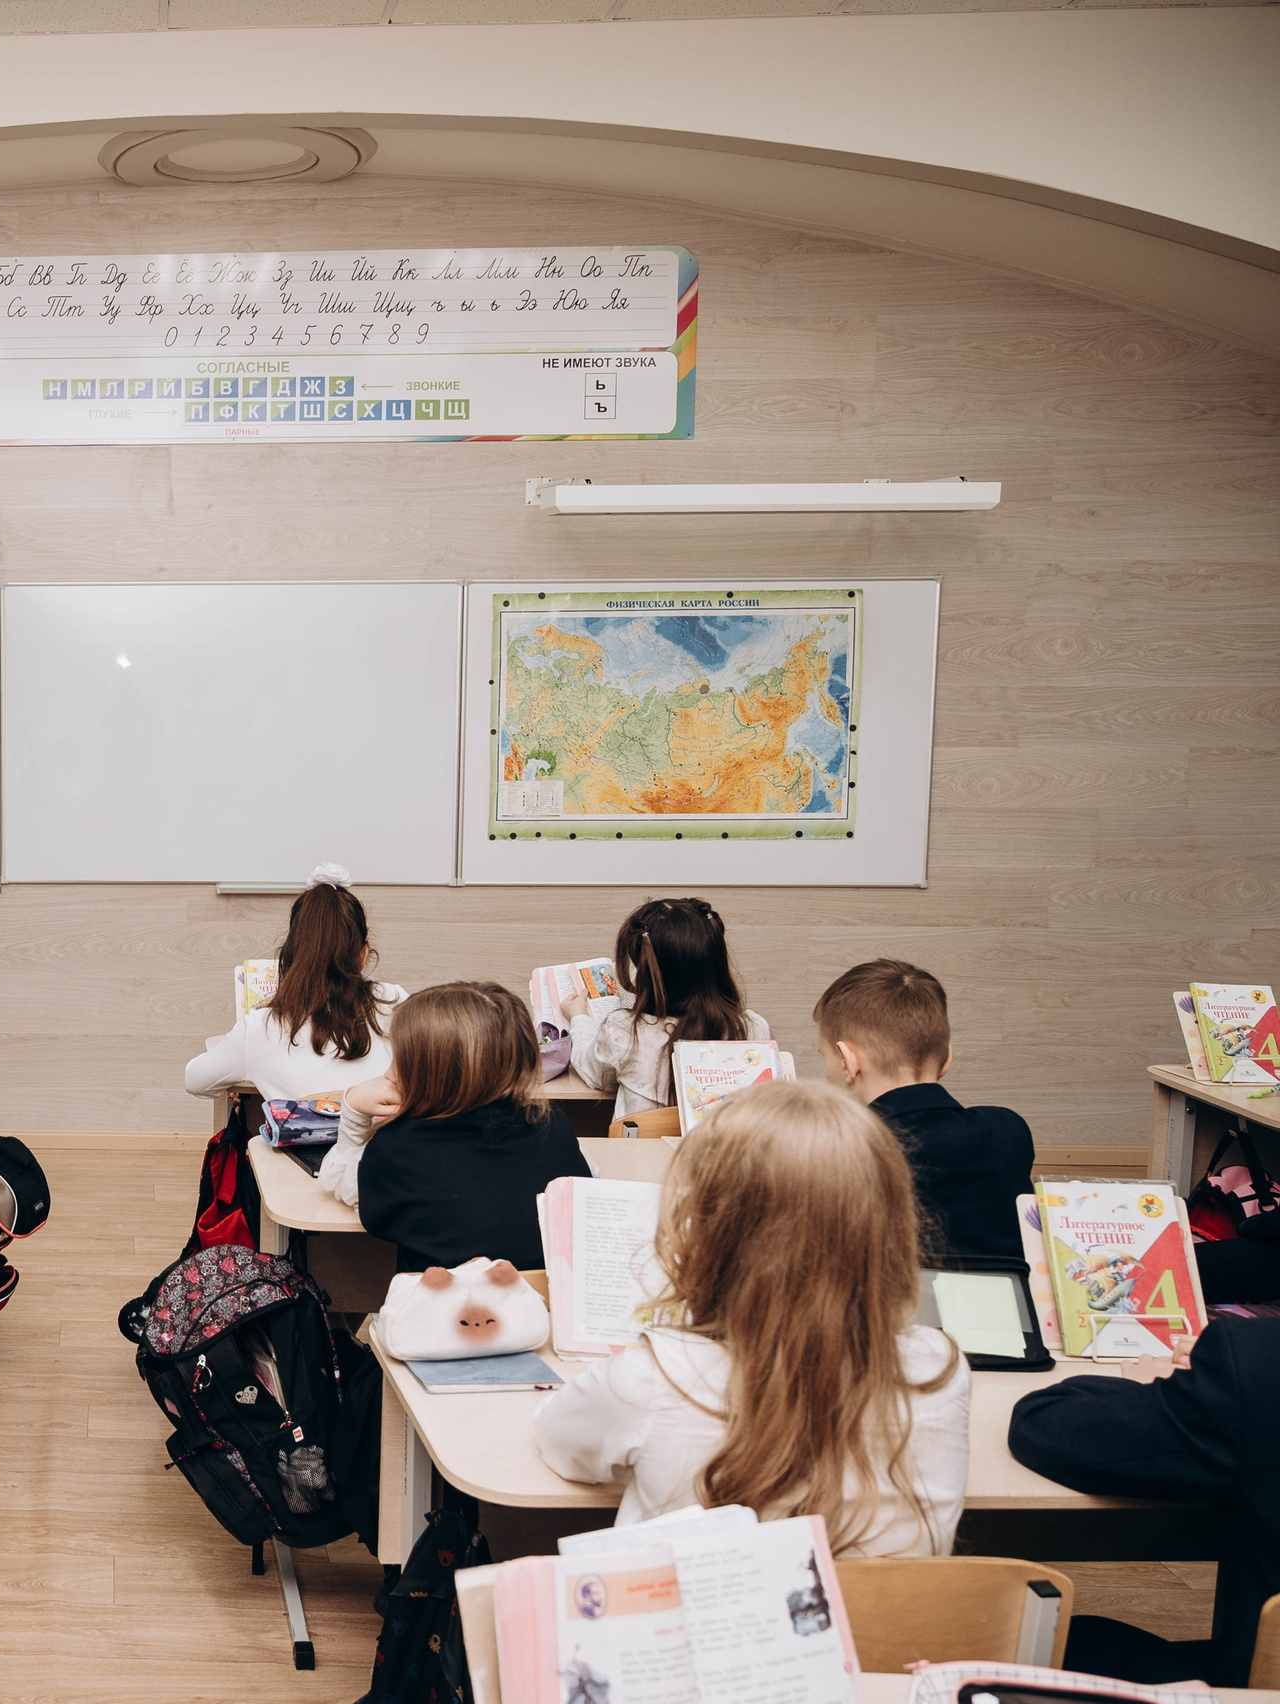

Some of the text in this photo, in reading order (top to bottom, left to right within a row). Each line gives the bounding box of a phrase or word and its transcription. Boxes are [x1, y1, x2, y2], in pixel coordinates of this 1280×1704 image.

[29, 264, 54, 286] Вв
[101, 263, 128, 292] Дд
[142, 262, 161, 284] Ее
[175, 259, 195, 284] Ёё
[208, 261, 257, 283] Жж
[273, 260, 293, 290] Зз
[309, 260, 336, 282] Ии
[351, 256, 377, 282] Йй
[393, 259, 419, 281] Кк
[431, 259, 464, 281] Лл
[476, 258, 520, 280] Мм
[534, 257, 565, 279] Нн
[579, 256, 604, 278] Оо
[618, 254, 653, 278] Пп
[7, 296, 27, 318] Сс
[99, 295, 121, 325] Уу
[135, 295, 164, 324] Фф
[179, 294, 215, 315] Хх
[231, 293, 261, 320] Цц
[280, 292, 302, 314] Чч
[318, 292, 356, 314] Шш
[372, 291, 415, 317] Щщ
[430, 300, 446, 313] ъ
[459, 299, 476, 312] ы
[490, 298, 500, 311] ь
[516, 289, 538, 311] Ээ
[552, 289, 589, 310] Юю
[601, 287, 629, 310] Яя
[164, 323, 430, 347] 0 1 2 3 4 5 6 7 8 9
[197, 362, 290, 375] СОГЛАСНЫЕ
[542, 357, 656, 369] НЕ ИМЕЮТ ЗВУКА
[406, 381, 460, 391] ЗВОНКИЕ
[88, 409, 131, 419] ГЛУХИЕ
[225, 428, 261, 436] ПАРНЫЕ
[606, 599, 760, 609] ФИЗИЧЕСКАЯ КАРТА РОССИИ
[1204, 1002, 1256, 1012] Литературное
[685, 1066, 747, 1076] Литературное
[1059, 1216, 1145, 1232] Литературное
[1075, 1232, 1136, 1245] ЧТЕНИЕ
[1145, 1269, 1187, 1330] 4
[1078, 1316, 1087, 1328] 2
